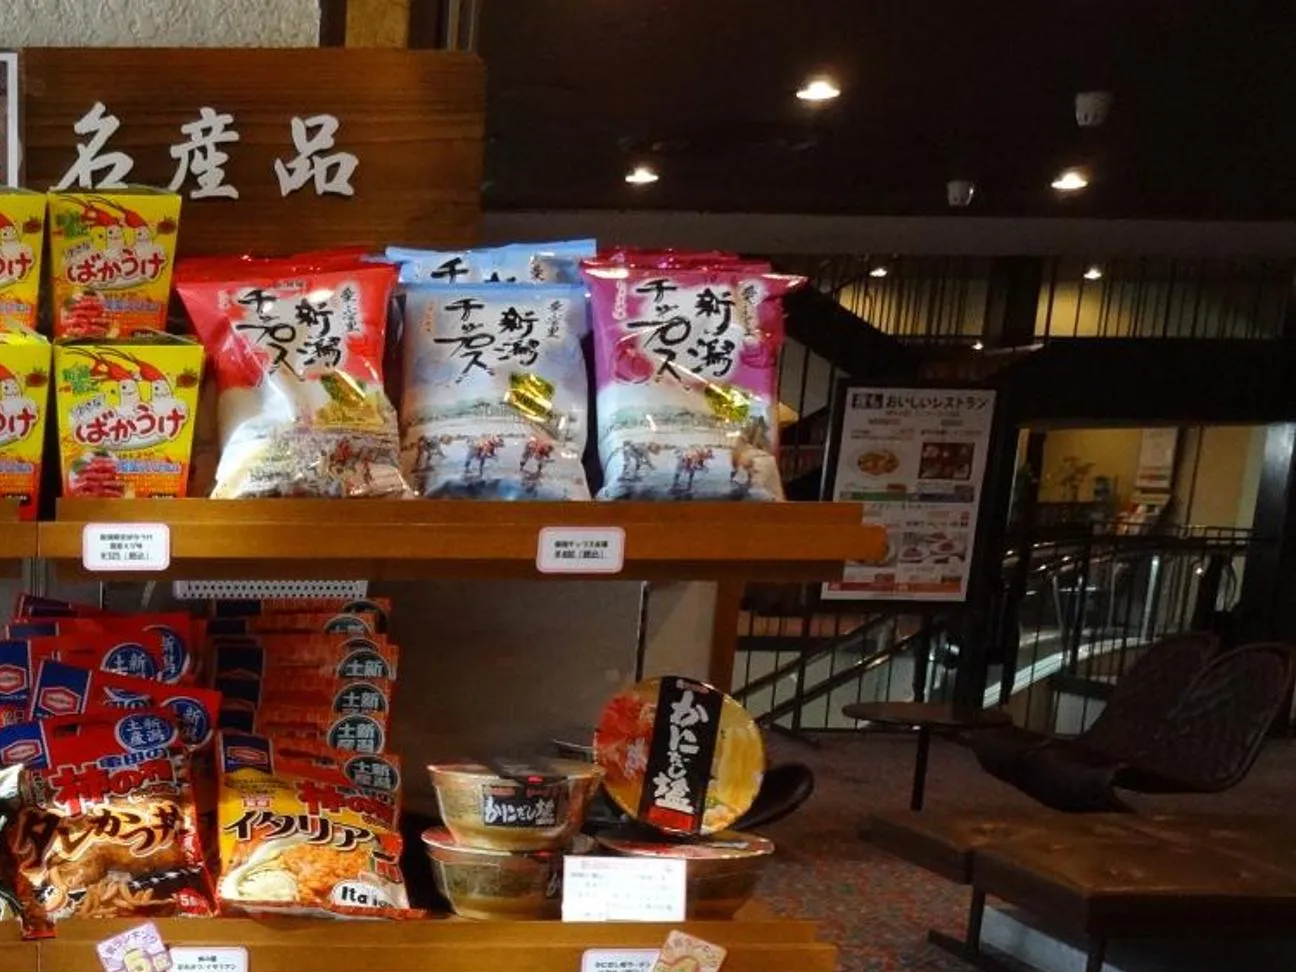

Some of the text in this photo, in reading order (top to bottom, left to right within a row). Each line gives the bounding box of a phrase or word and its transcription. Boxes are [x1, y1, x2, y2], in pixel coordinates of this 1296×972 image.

[52, 101, 360, 199] 名産品
[67, 249, 167, 285] ばかうけ
[885, 395, 989, 410] おいしいレストラン
[76, 403, 187, 444] ばかうけ
[653, 690, 710, 814] かにだし塩
[484, 796, 556, 825] かにだし塩
[17, 803, 189, 870] タレかつ丼
